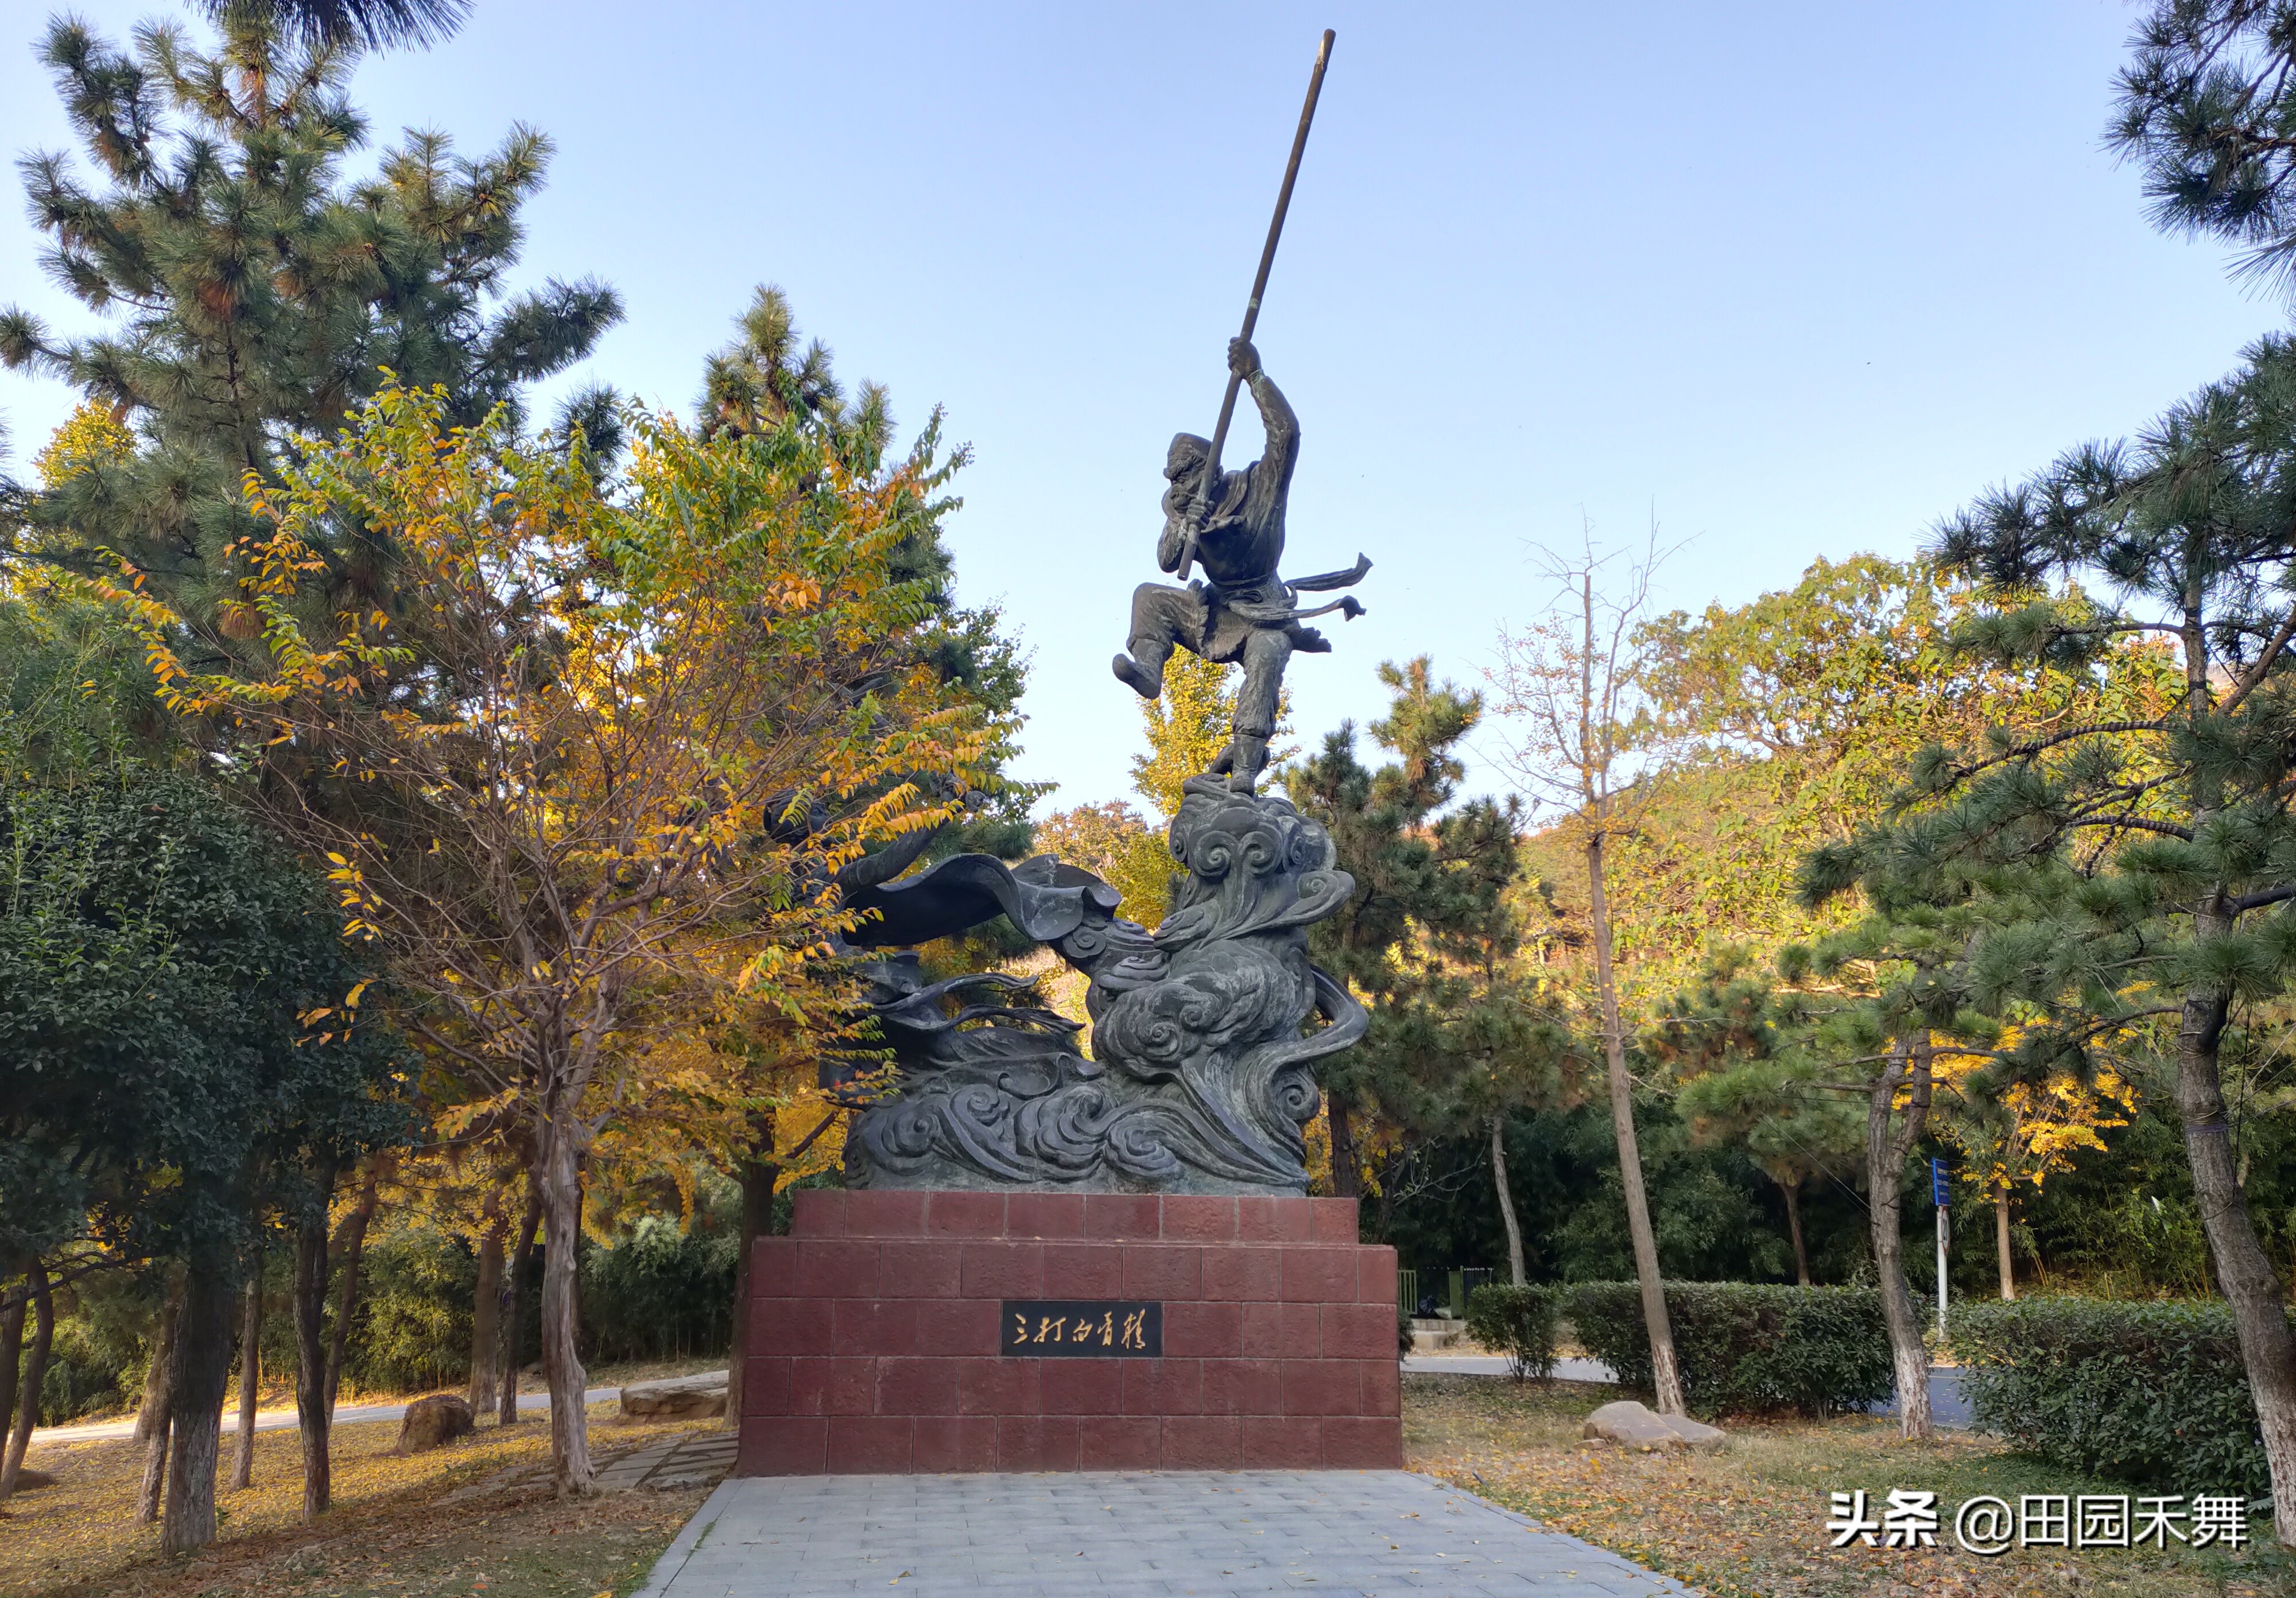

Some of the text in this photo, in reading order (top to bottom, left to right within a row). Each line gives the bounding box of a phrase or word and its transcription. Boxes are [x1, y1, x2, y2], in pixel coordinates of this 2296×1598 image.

[1013, 1308, 1146, 1349] 三打白骨精
